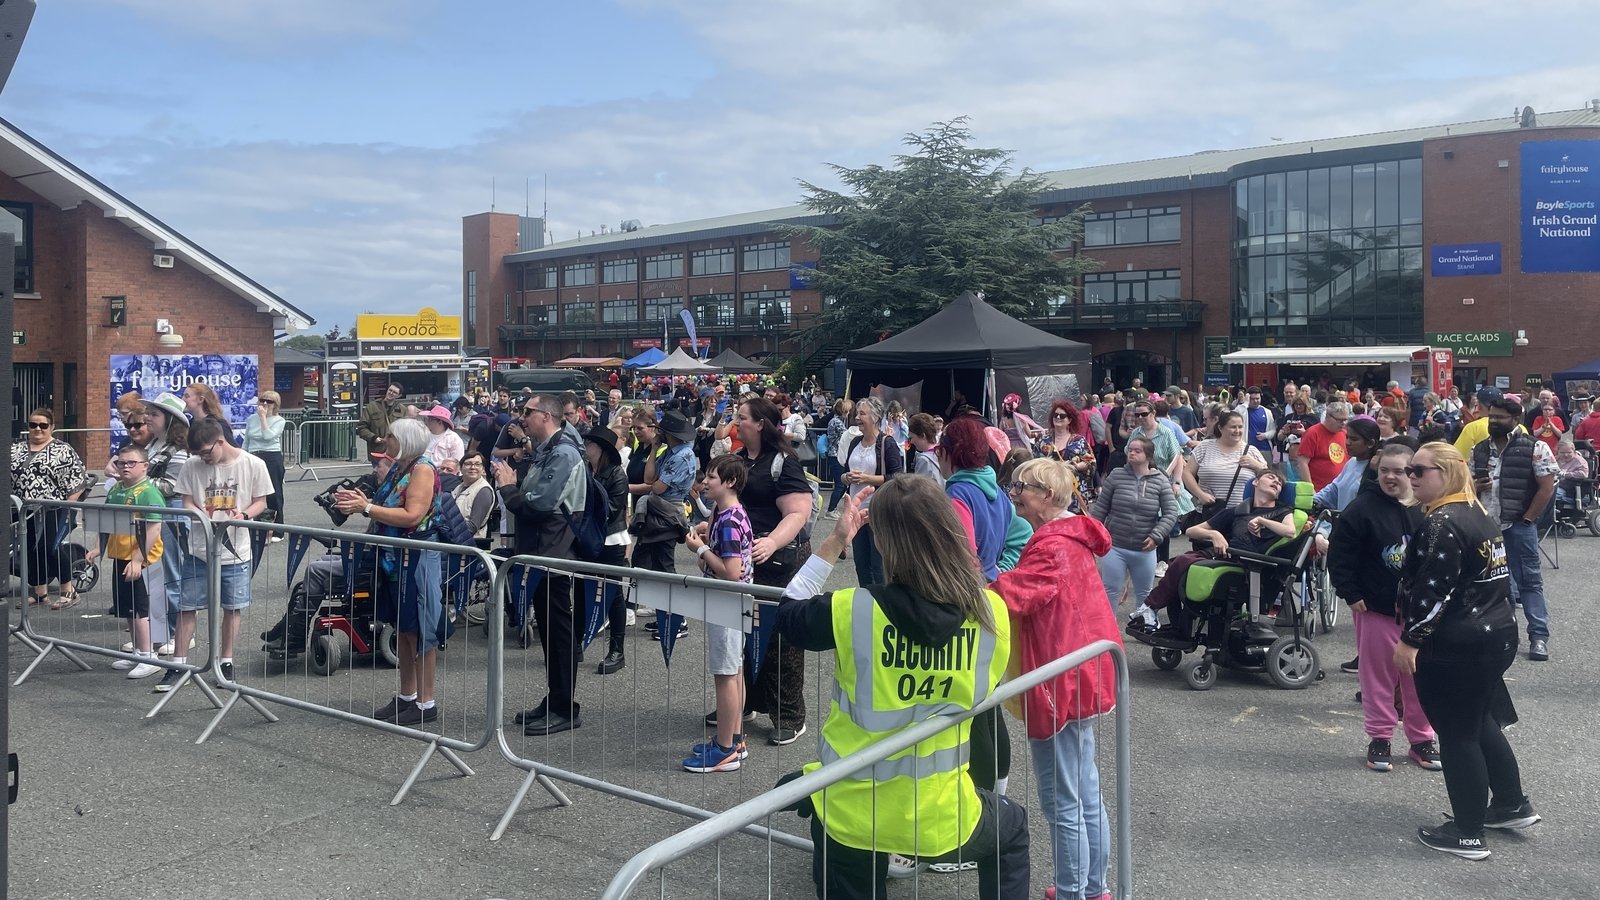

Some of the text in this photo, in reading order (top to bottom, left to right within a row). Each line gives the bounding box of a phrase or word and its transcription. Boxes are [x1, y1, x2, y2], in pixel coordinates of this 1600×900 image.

[1540, 164, 1589, 174] fairyhouse
[1536, 200, 1595, 211] BoyleSports
[1532, 214, 1597, 226] Irish Grand
[1540, 226, 1591, 238] National
[1462, 254, 1494, 262] National
[382, 322, 438, 336] foodoo
[1436, 333, 1500, 343] RACE CARDS
[1457, 347, 1479, 355] ATM
[131, 370, 242, 391] fairyhouse
[882, 624, 976, 670] SECURITY
[898, 674, 953, 701] 041
